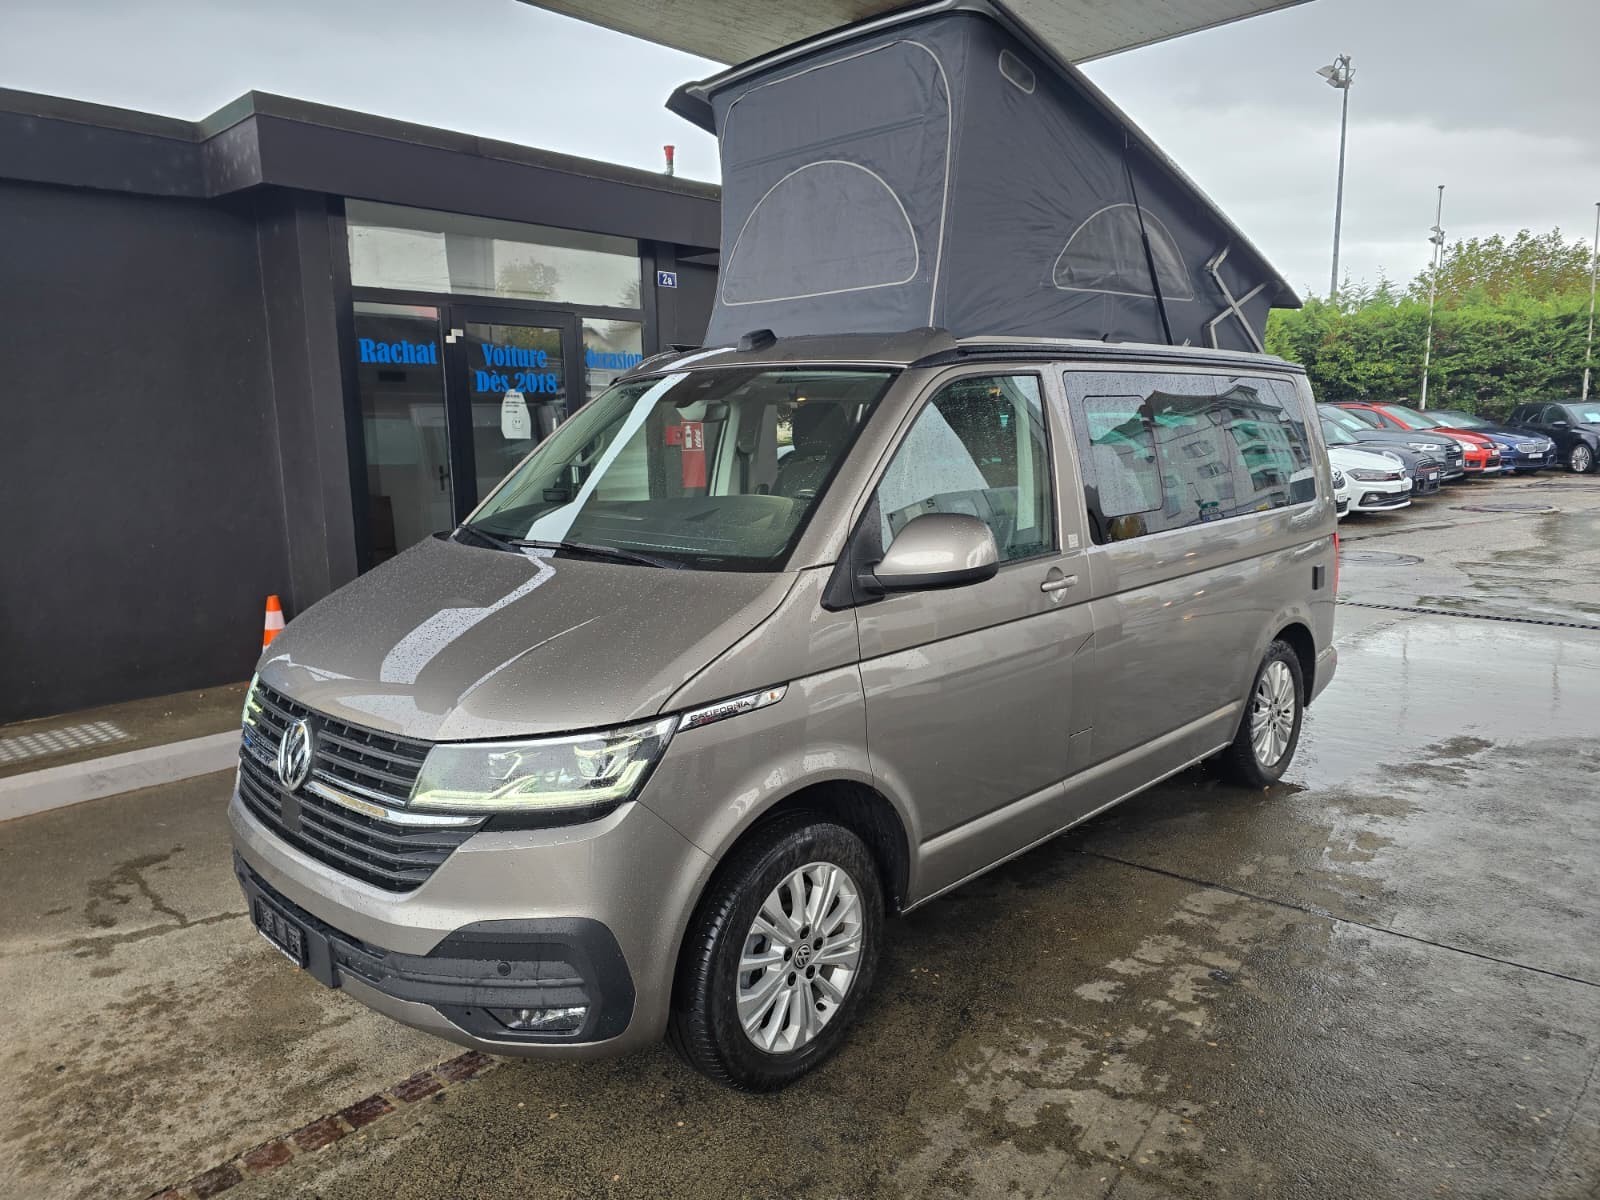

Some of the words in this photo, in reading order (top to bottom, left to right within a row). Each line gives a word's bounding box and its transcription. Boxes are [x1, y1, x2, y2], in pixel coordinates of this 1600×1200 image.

[662, 273, 673, 286] 2a
[359, 337, 438, 365] Rachat
[481, 342, 548, 368] Voiture
[475, 369, 510, 393] Dès
[514, 371, 558, 394] 2018
